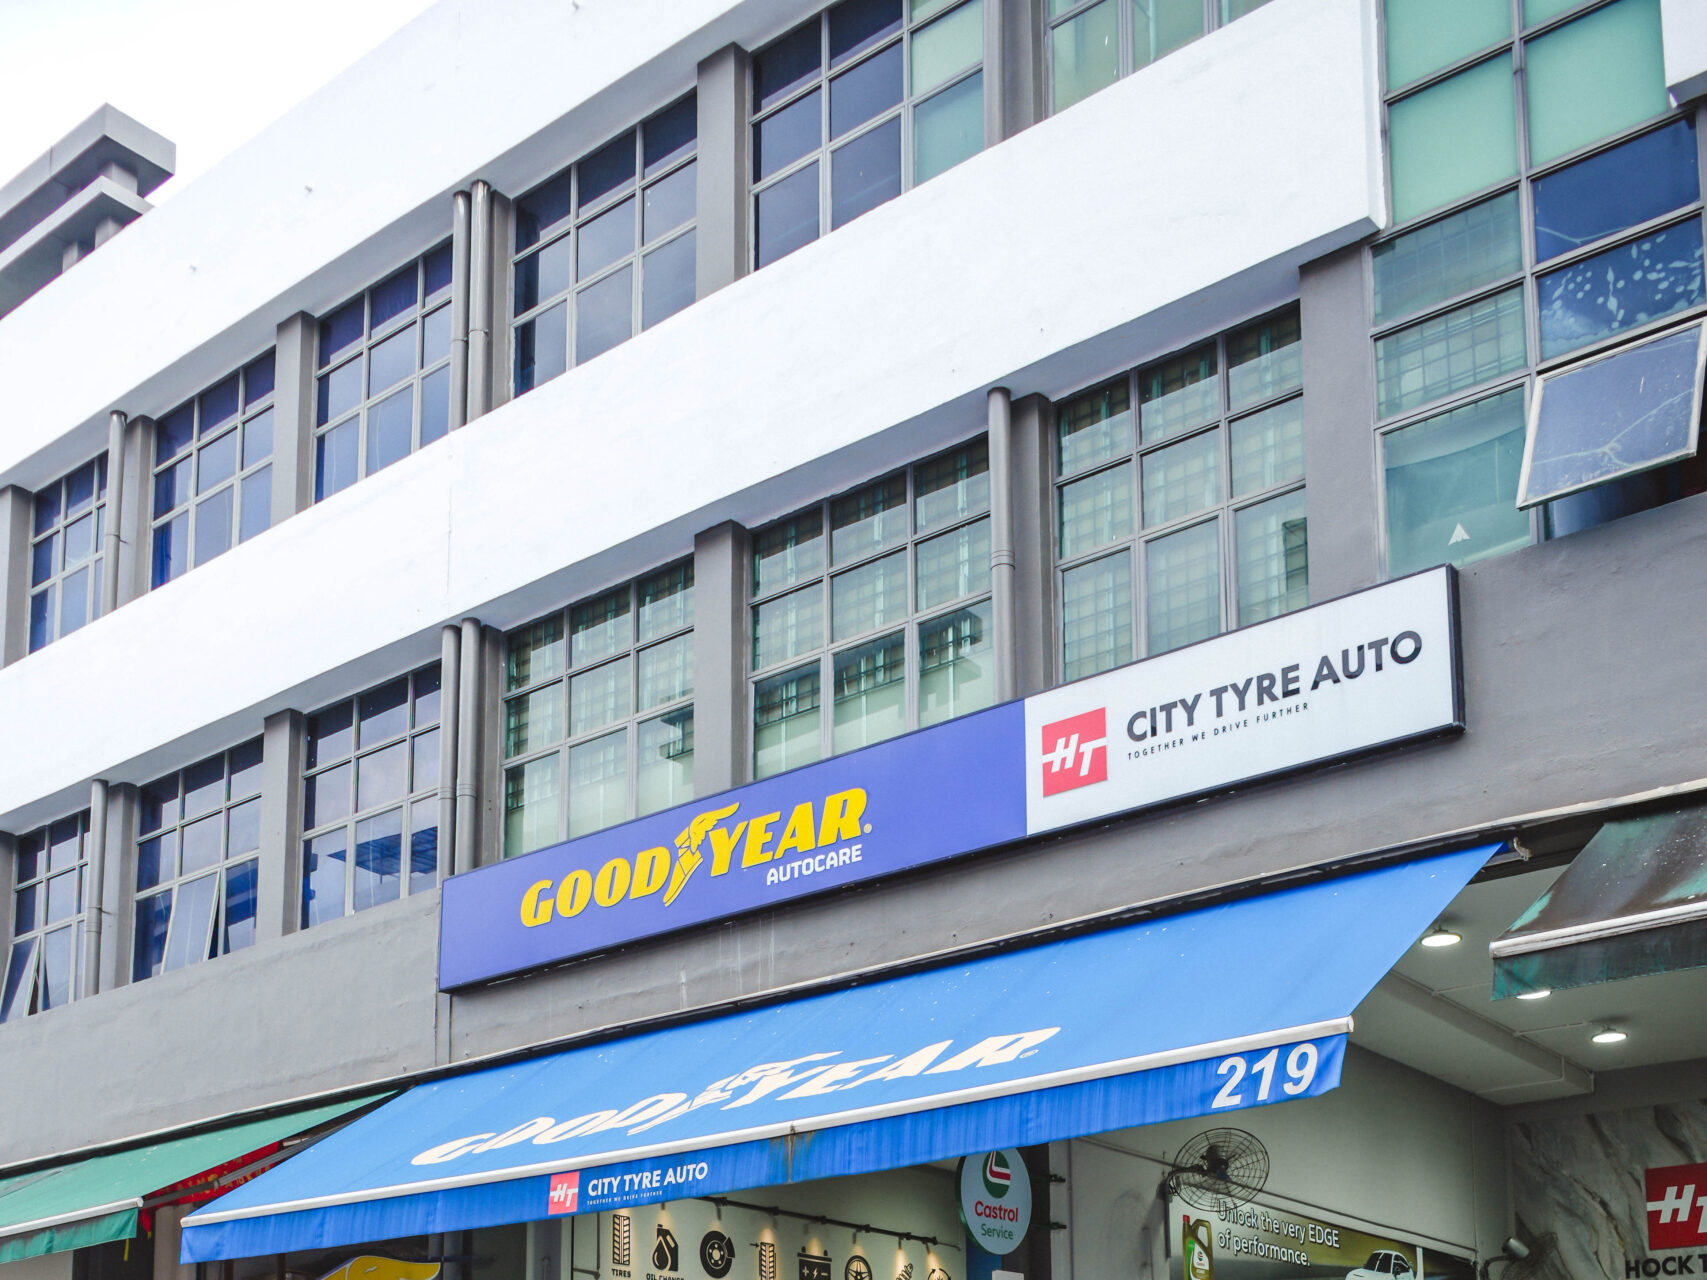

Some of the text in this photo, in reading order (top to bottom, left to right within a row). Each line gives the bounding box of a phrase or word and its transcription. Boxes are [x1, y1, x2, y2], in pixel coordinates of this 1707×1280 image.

[1127, 630, 1422, 742] CITY TYRE AUTO
[1128, 702, 1308, 760] TOGETHER WE DRIVE FURTHER
[1042, 733, 1107, 777] HT
[520, 788, 867, 928] GOODYEAR
[766, 844, 862, 886] AUTOCARE
[1211, 1043, 1318, 1109] 219
[550, 1183, 578, 1207] HT
[588, 1162, 708, 1197] CITY TYRE AUTO
[975, 1200, 1019, 1222] Castrol
[1217, 1200, 1340, 1248] Unlock the very EDGE
[981, 1223, 1014, 1240] Service
[1217, 1228, 1310, 1266] of performance.
[611, 1268, 631, 1278] TIRES
[1625, 1255, 1695, 1279] HOCK
